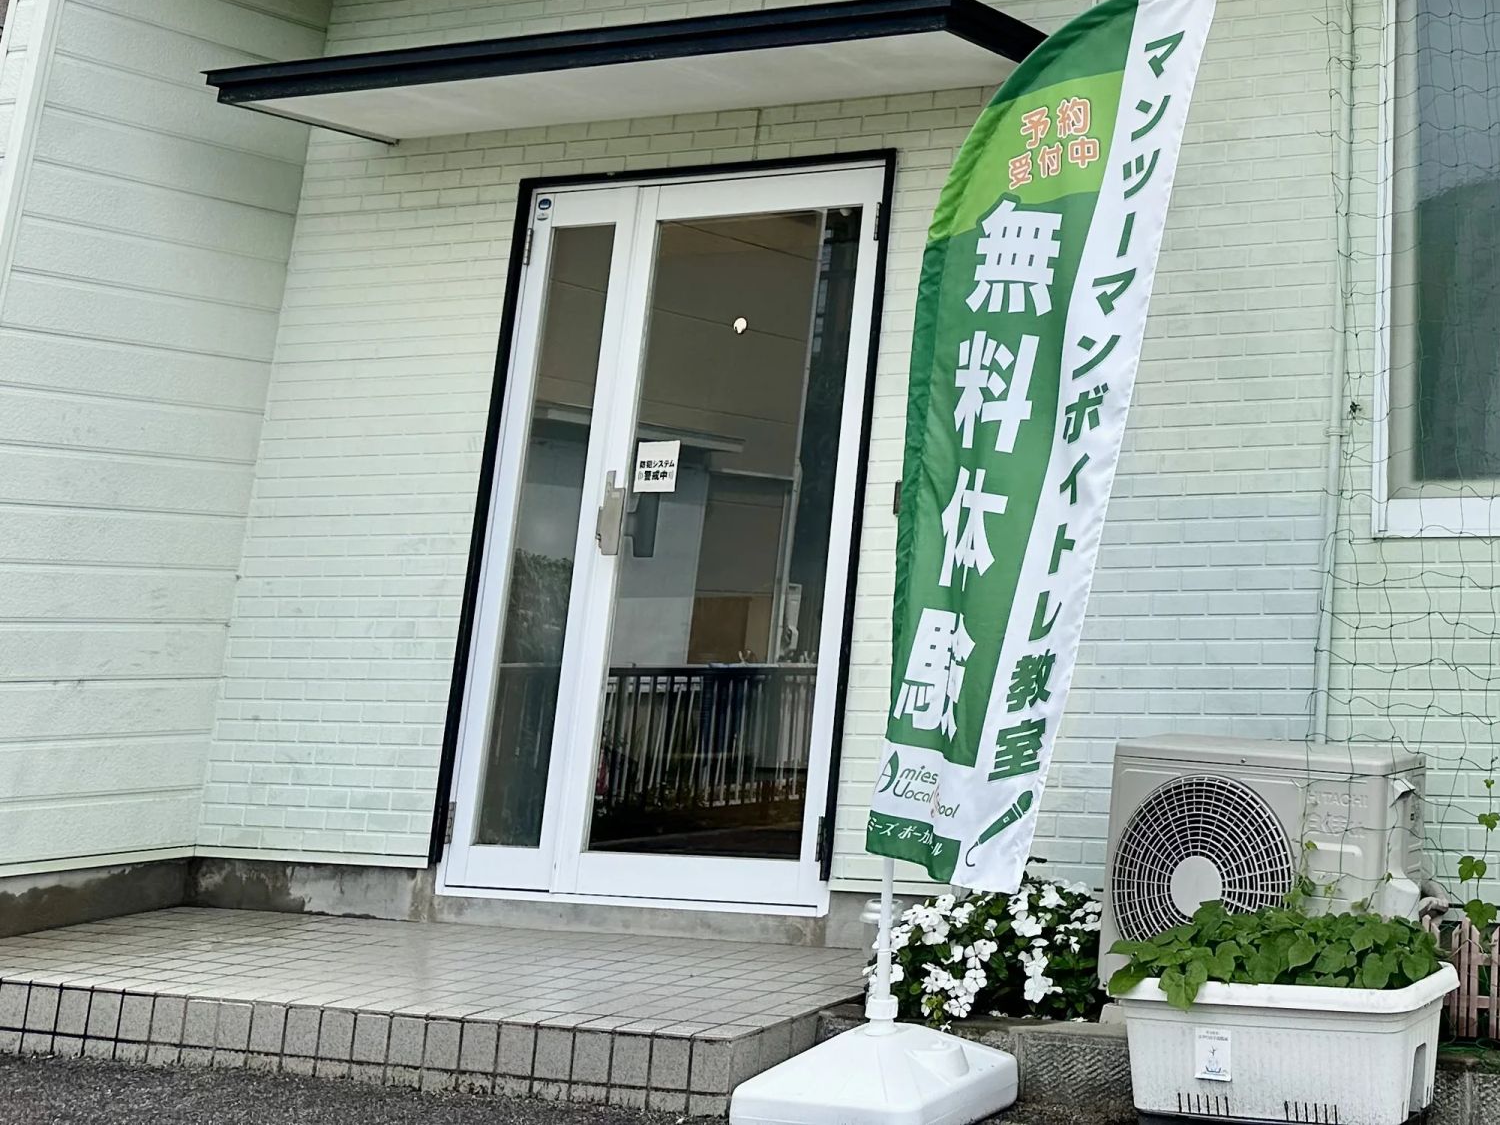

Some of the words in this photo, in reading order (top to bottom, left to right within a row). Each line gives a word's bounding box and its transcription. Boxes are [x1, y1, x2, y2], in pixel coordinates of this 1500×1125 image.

[1021, 96, 1091, 149] 予約
[1008, 136, 1100, 190] 受付中
[987, 30, 1185, 782] マンツーマンボイトレ教室
[893, 198, 1063, 743] 無料体験
[1306, 790, 1369, 808] HITACHI
[867, 817, 900, 836] ミーズ
